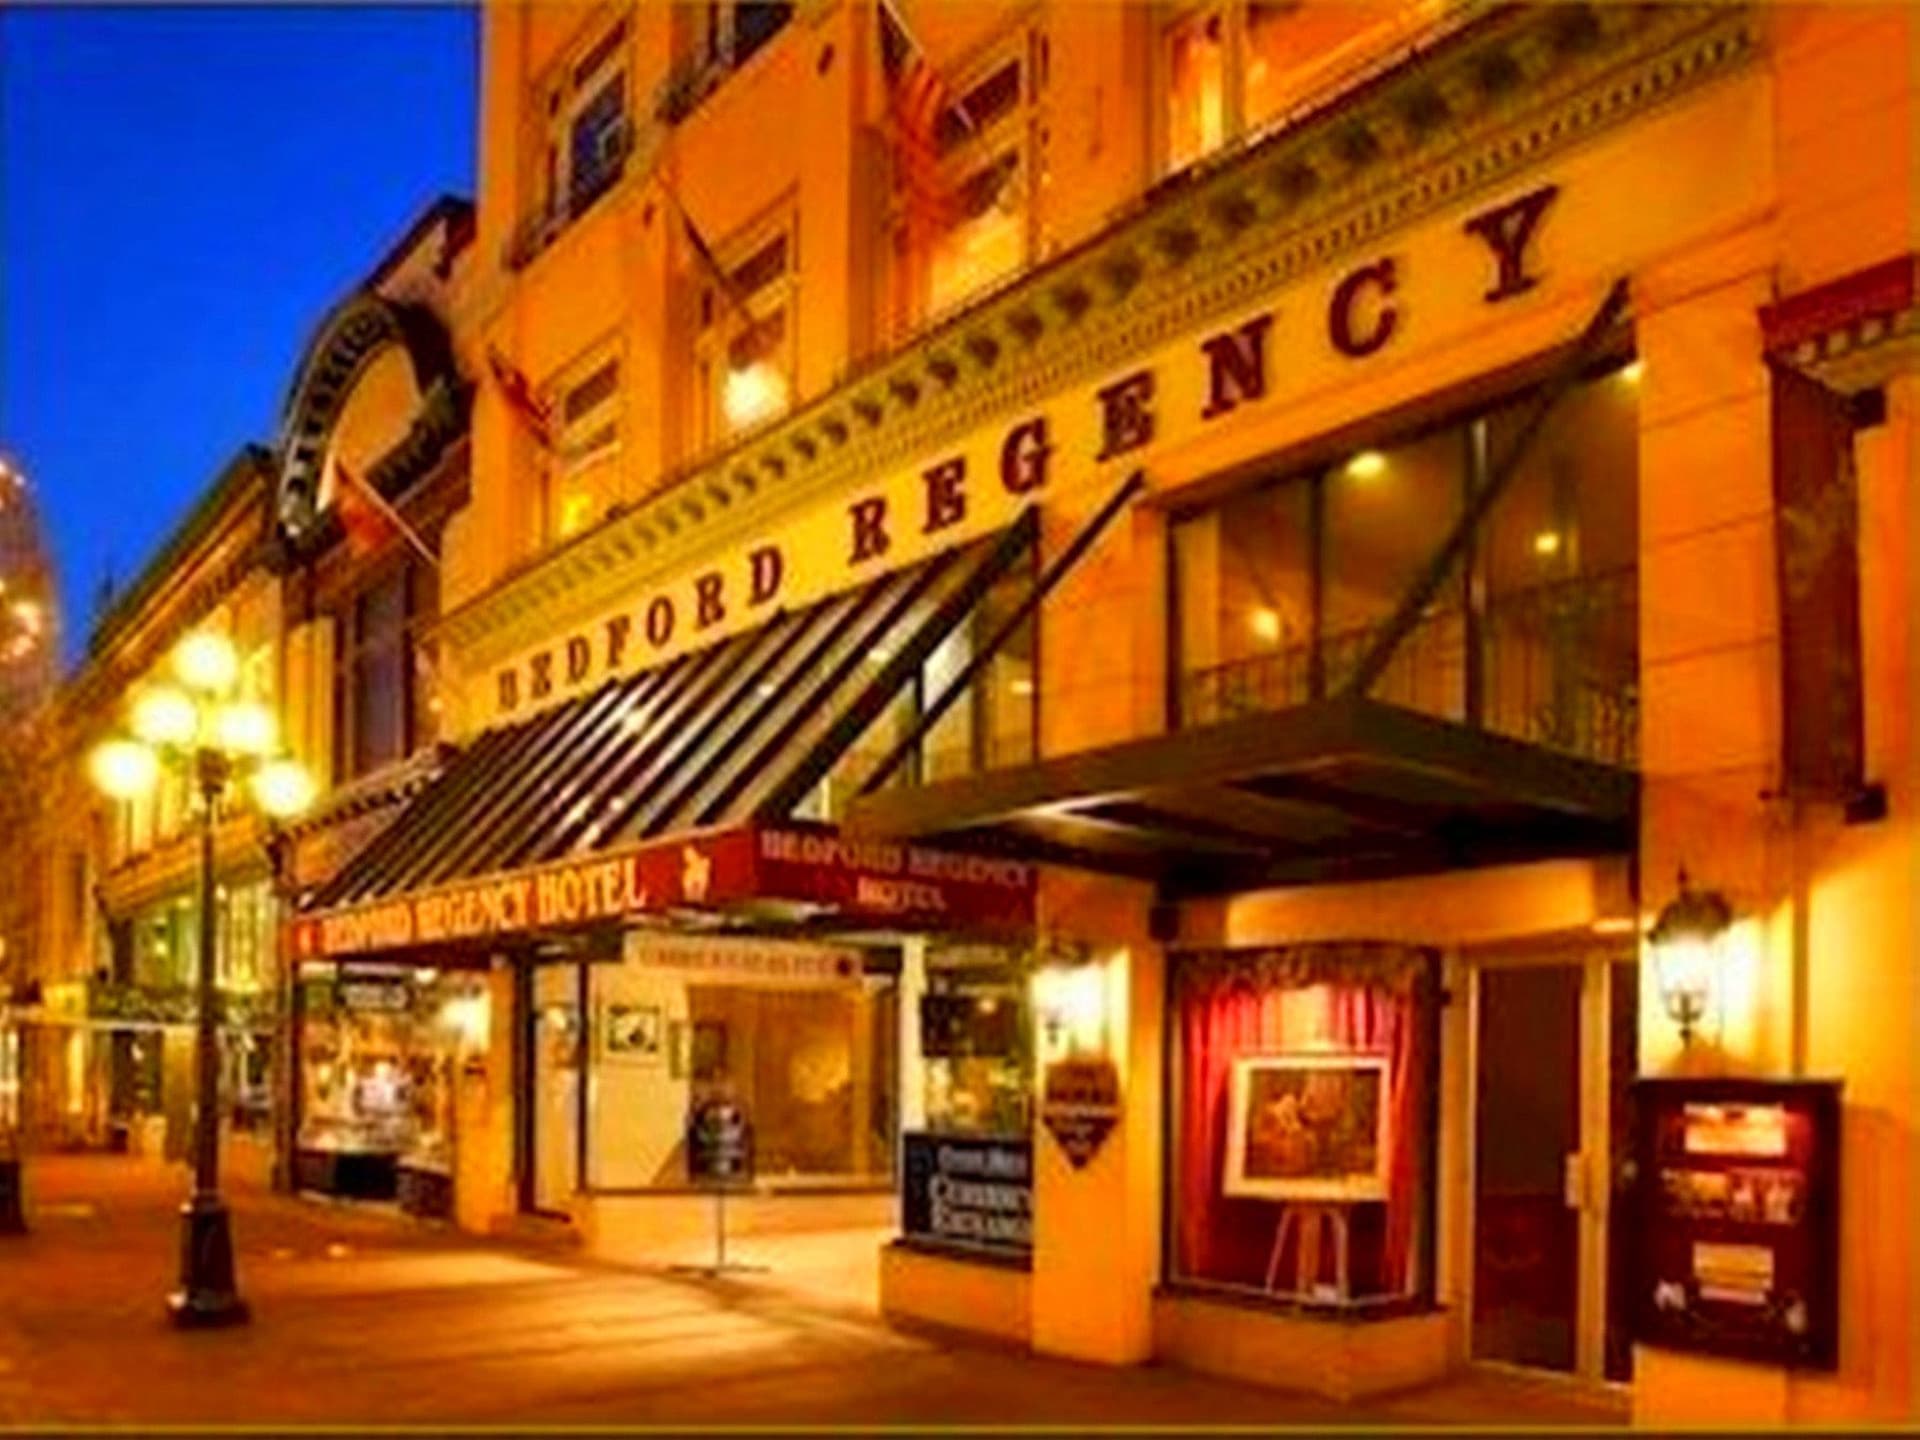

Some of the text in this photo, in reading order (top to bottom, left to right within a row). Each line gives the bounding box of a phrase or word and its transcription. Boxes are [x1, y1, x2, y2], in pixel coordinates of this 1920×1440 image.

[497, 184, 1560, 713] BEDFORD REGENCY
[762, 829, 900, 873] BEDFORD
[322, 857, 647, 955] BEDFORD REGENCY HOTEL
[857, 876, 947, 911] HOTEL
